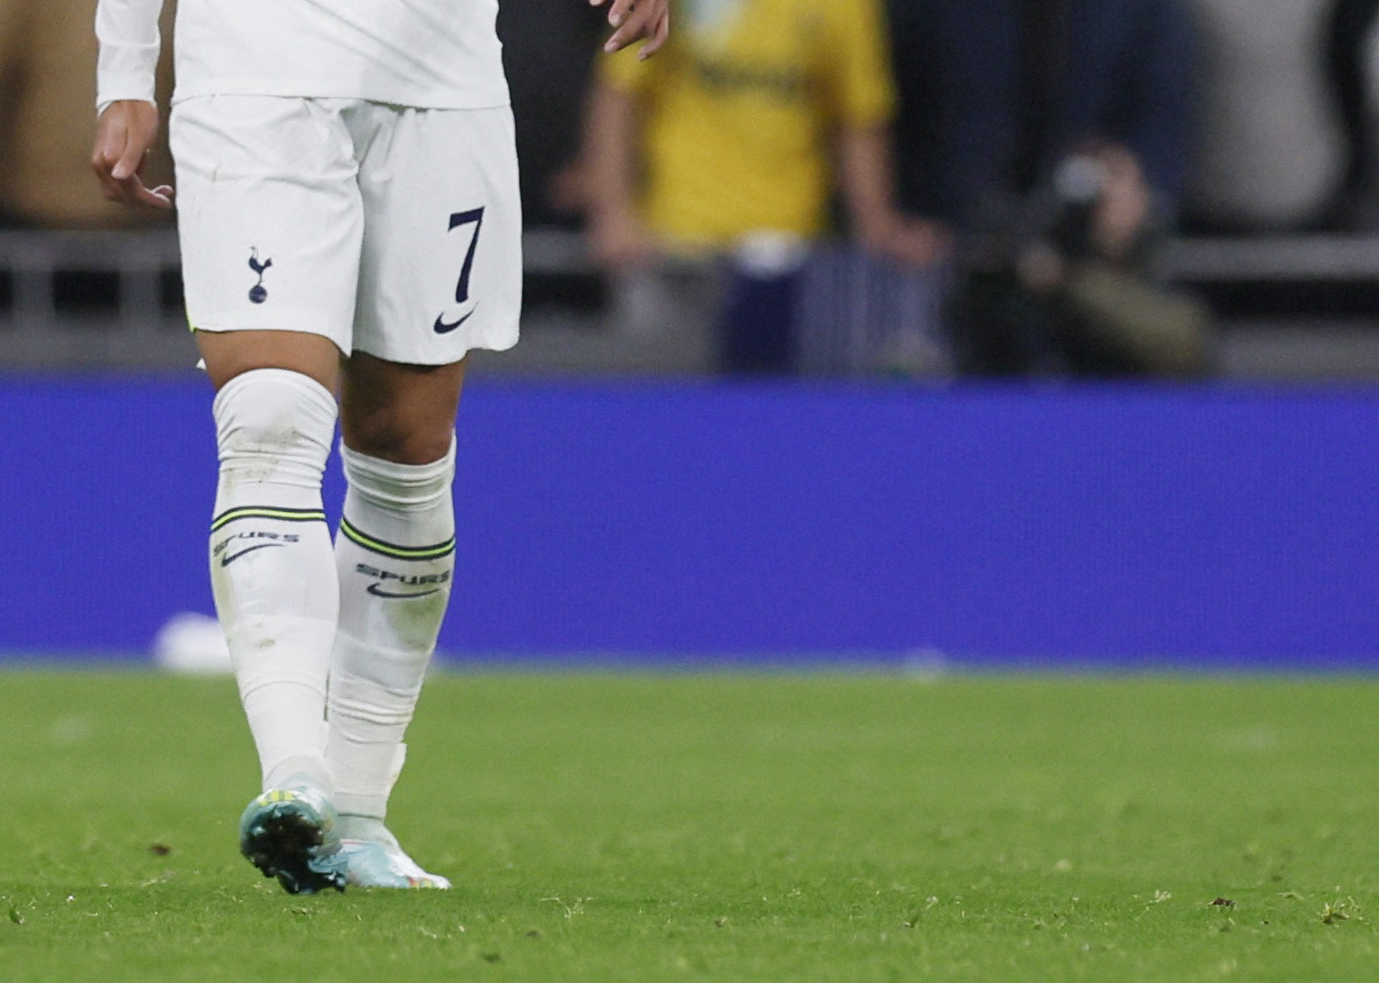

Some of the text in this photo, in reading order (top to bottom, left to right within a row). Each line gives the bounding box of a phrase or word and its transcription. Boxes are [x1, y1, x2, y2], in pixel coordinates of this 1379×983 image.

[447, 205, 485, 304] 7
[214, 531, 300, 557] SPURS
[356, 563, 451, 585] SPURS
